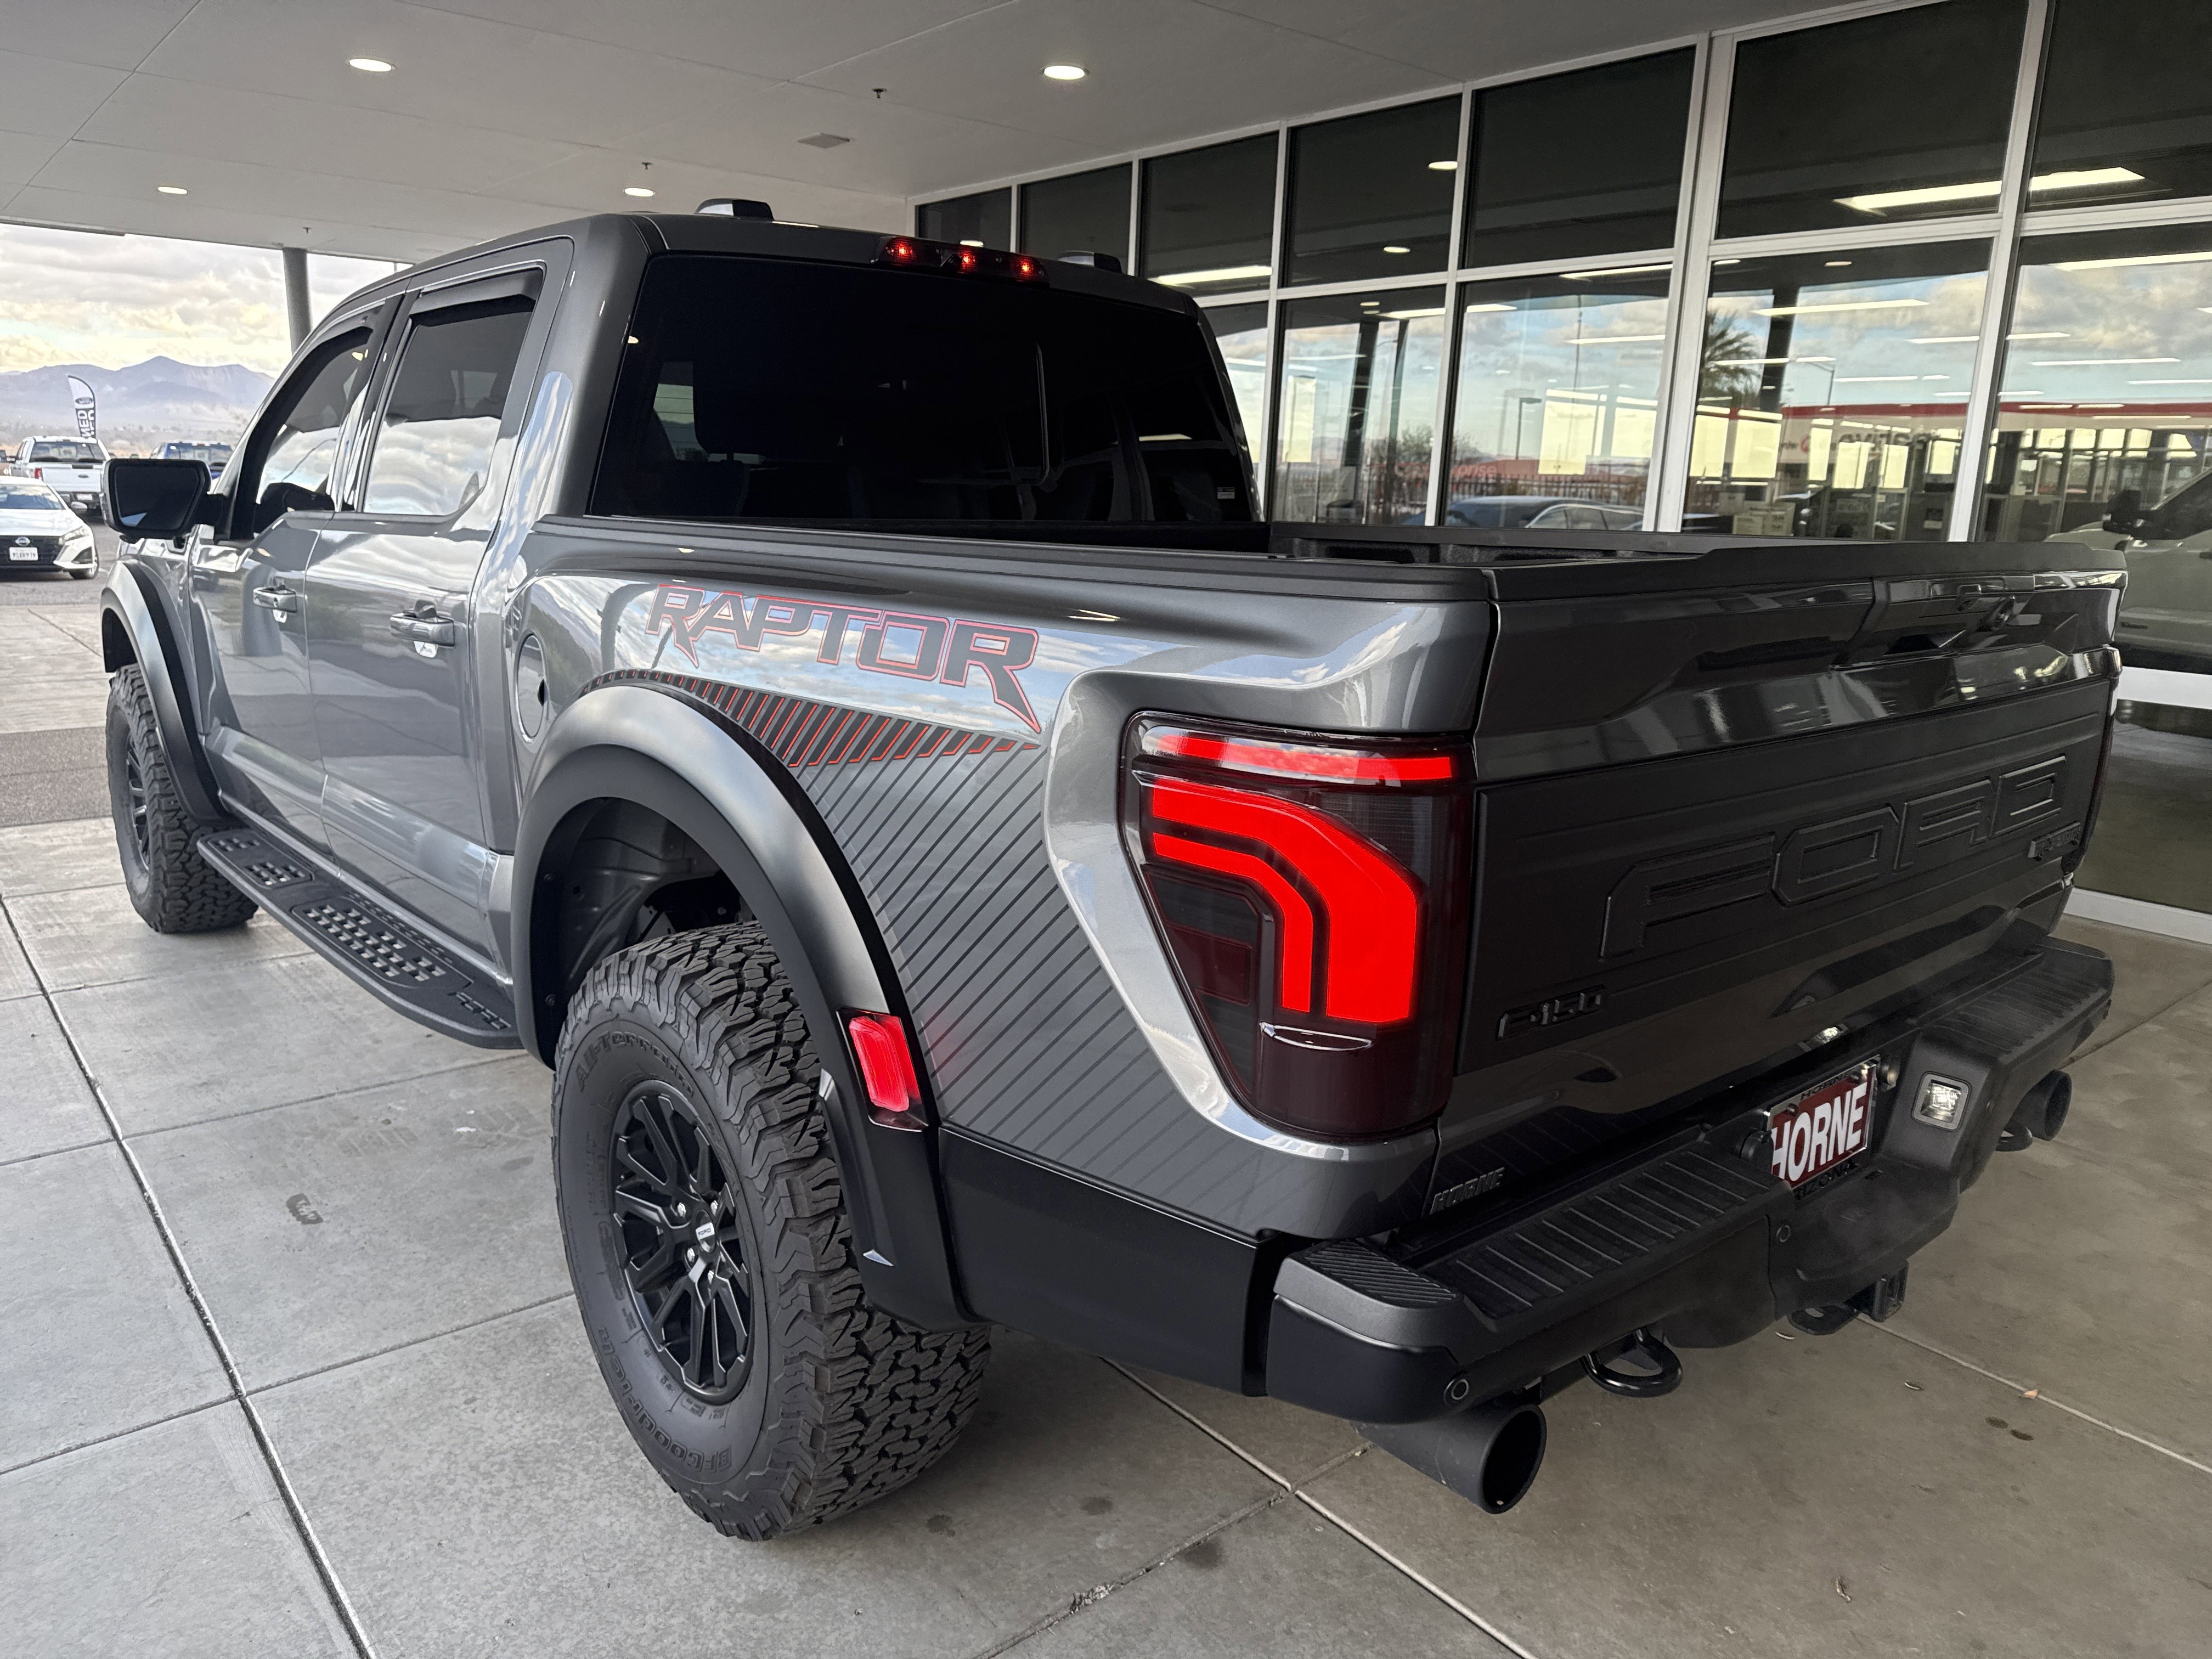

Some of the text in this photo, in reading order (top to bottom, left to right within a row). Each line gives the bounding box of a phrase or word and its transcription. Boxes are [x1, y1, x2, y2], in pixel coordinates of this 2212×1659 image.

[645, 583, 1042, 734] RAPTOR
[1599, 754, 2068, 962] FORD
[1430, 1167, 1505, 1216] HORNE
[1770, 1081, 1867, 1182] HORNE
[598, 1326, 732, 1474] BFGoodrich
